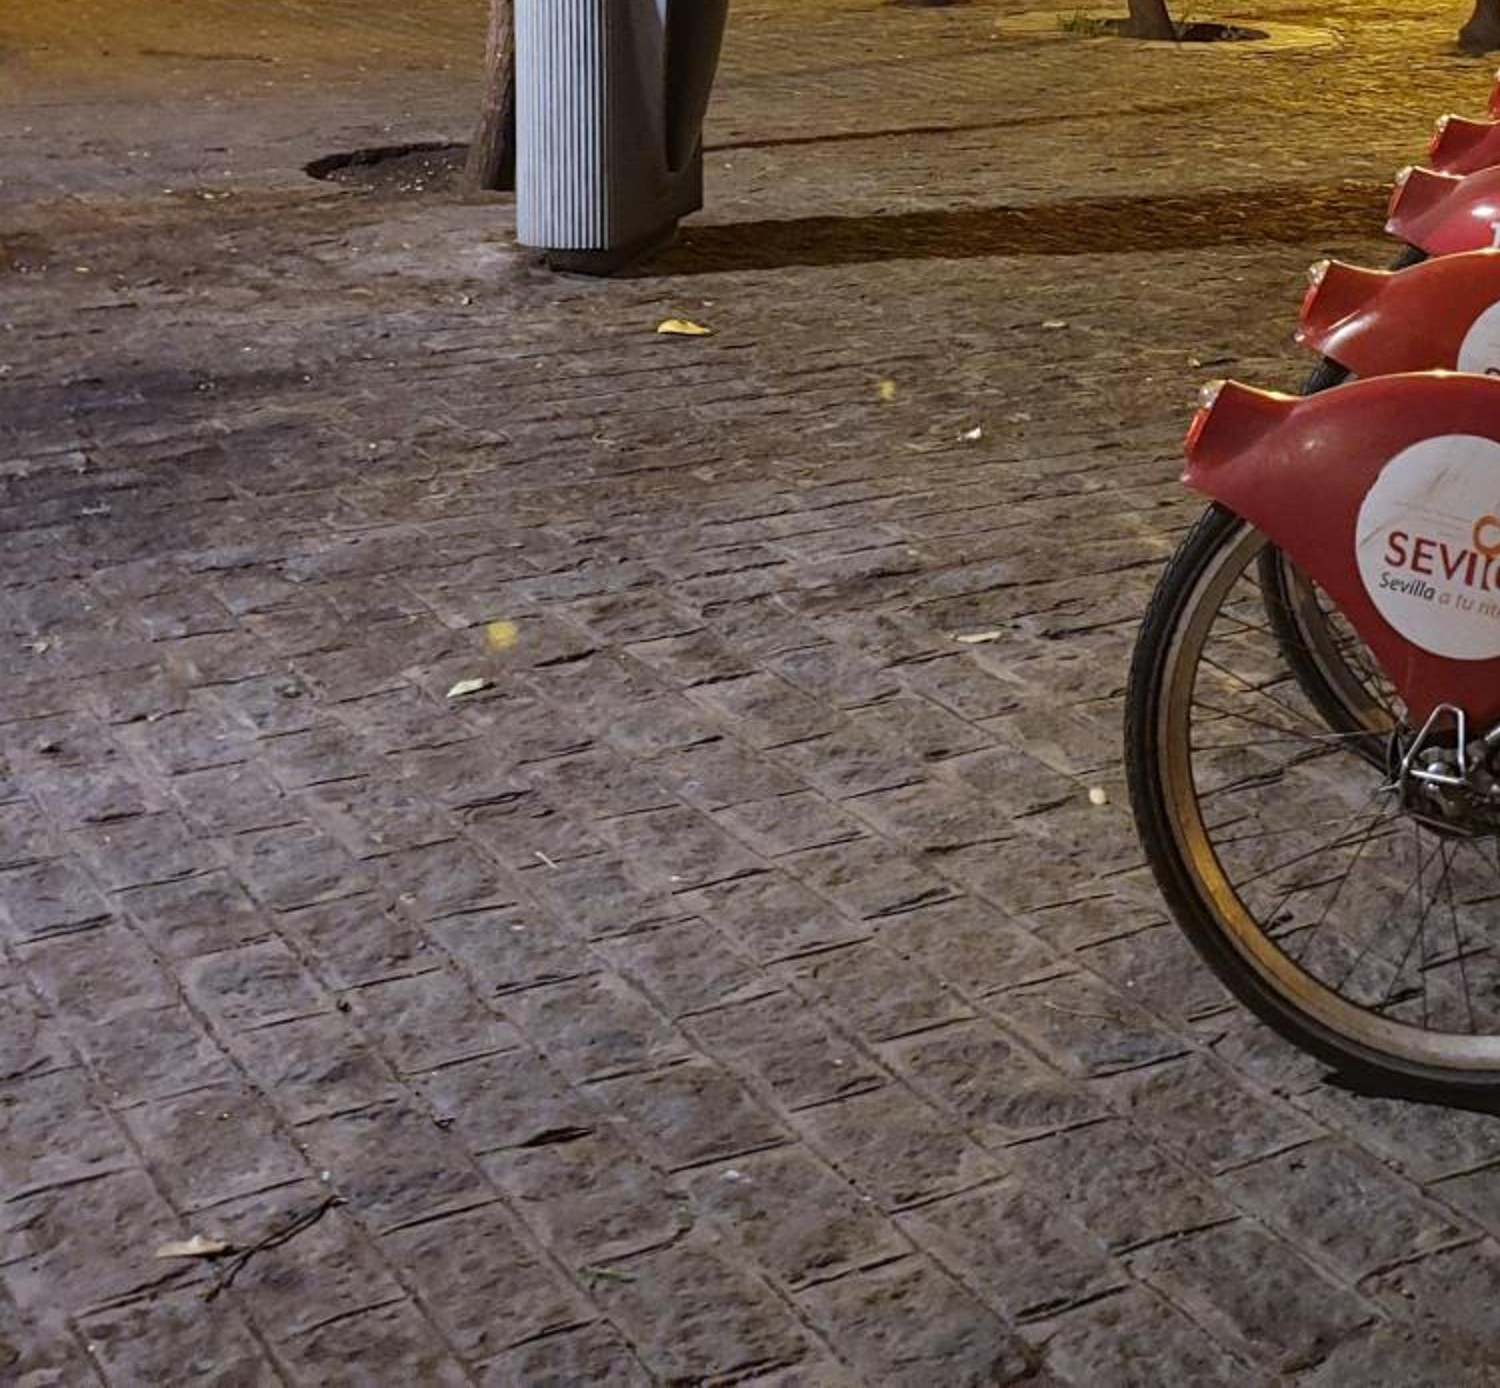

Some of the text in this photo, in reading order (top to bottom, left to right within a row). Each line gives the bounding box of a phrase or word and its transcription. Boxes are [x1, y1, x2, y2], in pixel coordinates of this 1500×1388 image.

[1379, 571, 1437, 602] Sevilla
[1438, 593, 1452, 606] a
[1456, 593, 1476, 612] tu
